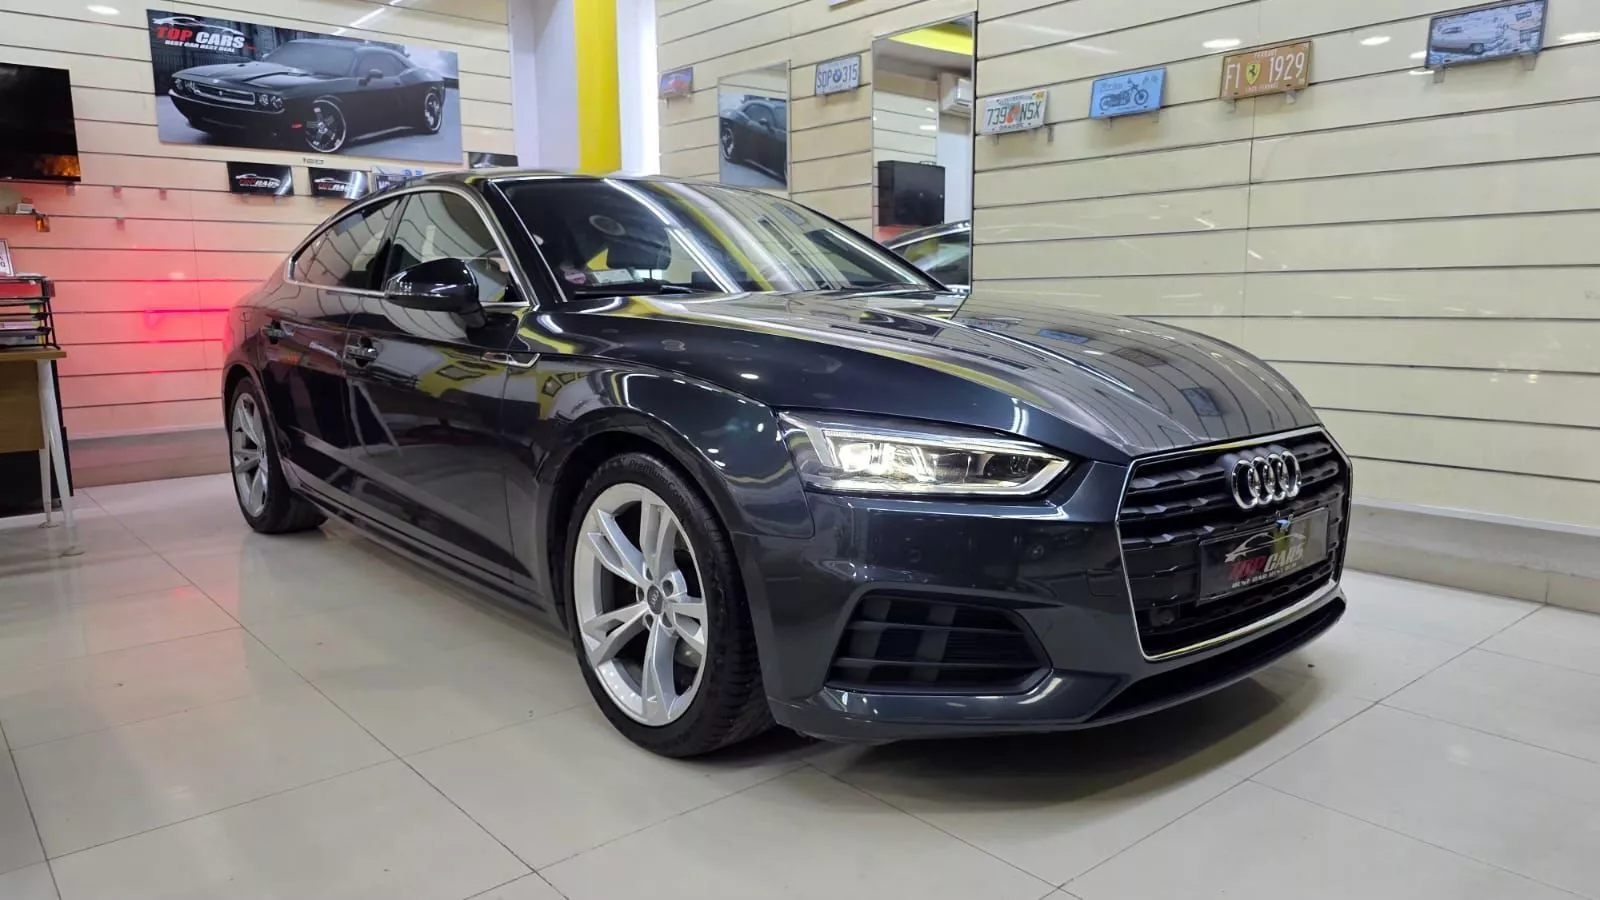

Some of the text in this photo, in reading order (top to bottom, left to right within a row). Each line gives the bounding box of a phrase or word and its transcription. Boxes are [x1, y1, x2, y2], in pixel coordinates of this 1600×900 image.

[156, 26, 245, 49] TOP CARS
[842, 63, 858, 82] 315
[1225, 52, 1305, 90] F1 1929
[987, 101, 1041, 126] 739 NSX
[1263, 544, 1303, 573] CARS
